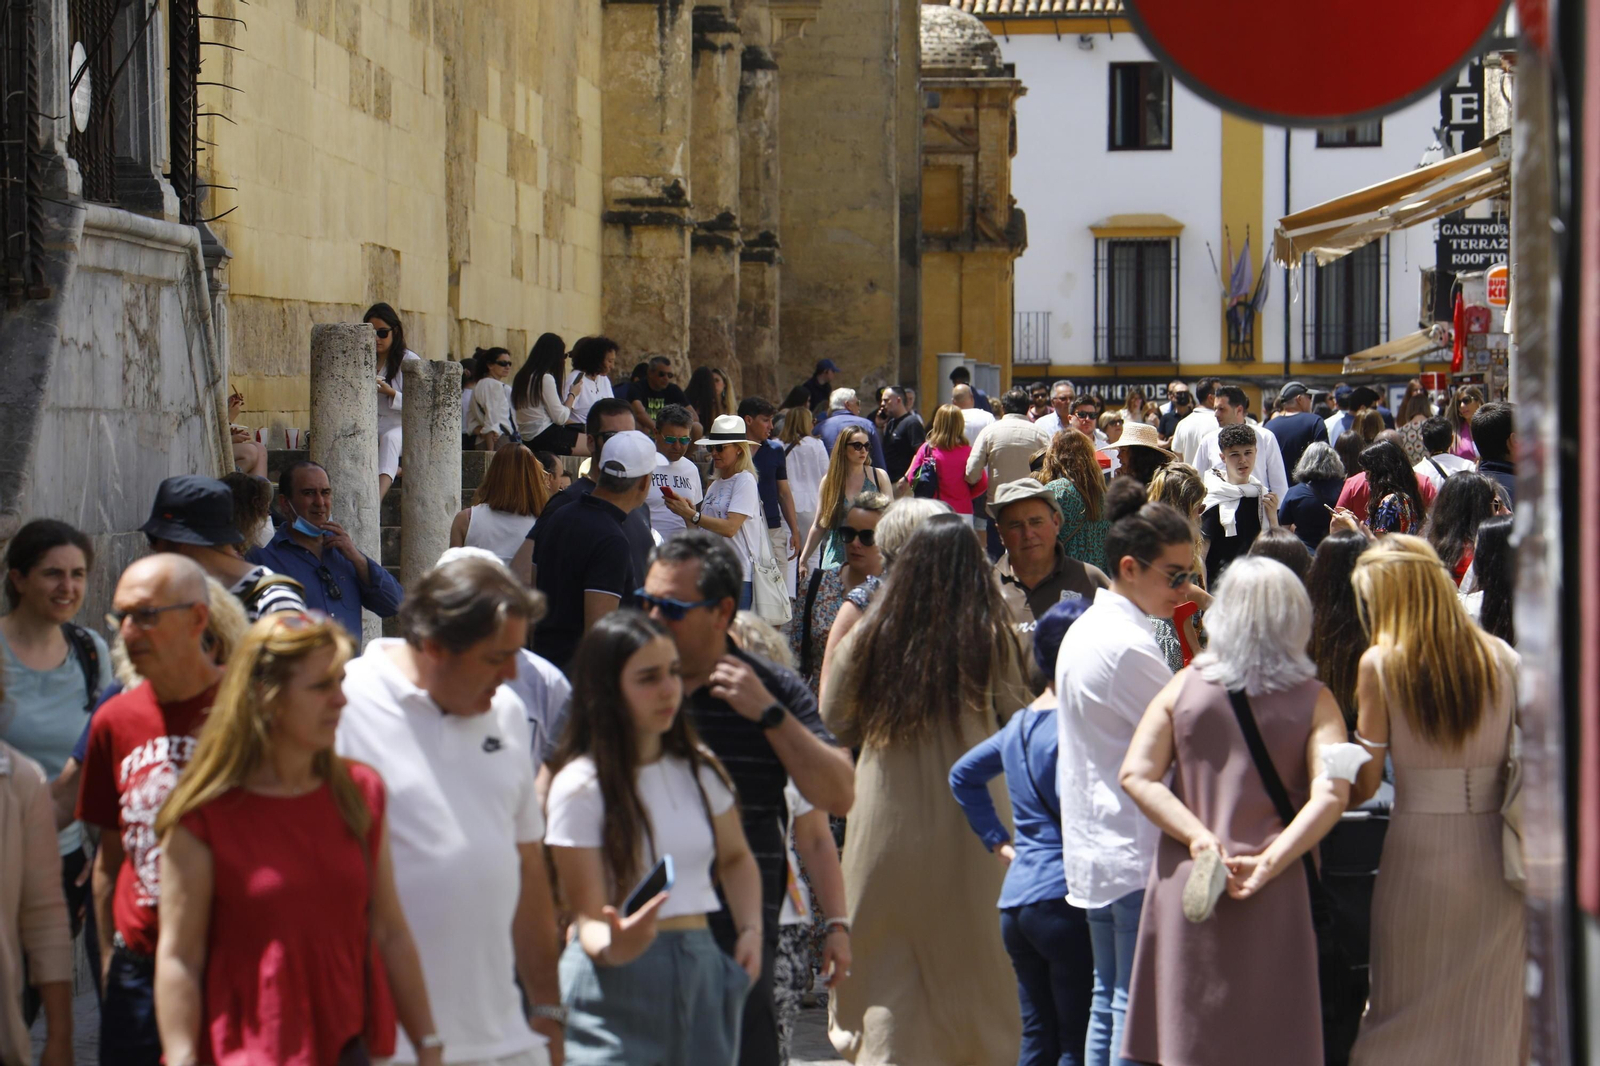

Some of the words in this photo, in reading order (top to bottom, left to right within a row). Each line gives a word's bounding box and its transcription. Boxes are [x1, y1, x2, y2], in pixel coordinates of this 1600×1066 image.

[1449, 238, 1508, 250] TERRAZ
[1451, 252, 1507, 265] ROOFTO
[652, 473, 669, 487] PEPE
[673, 475, 692, 490] JEANS
